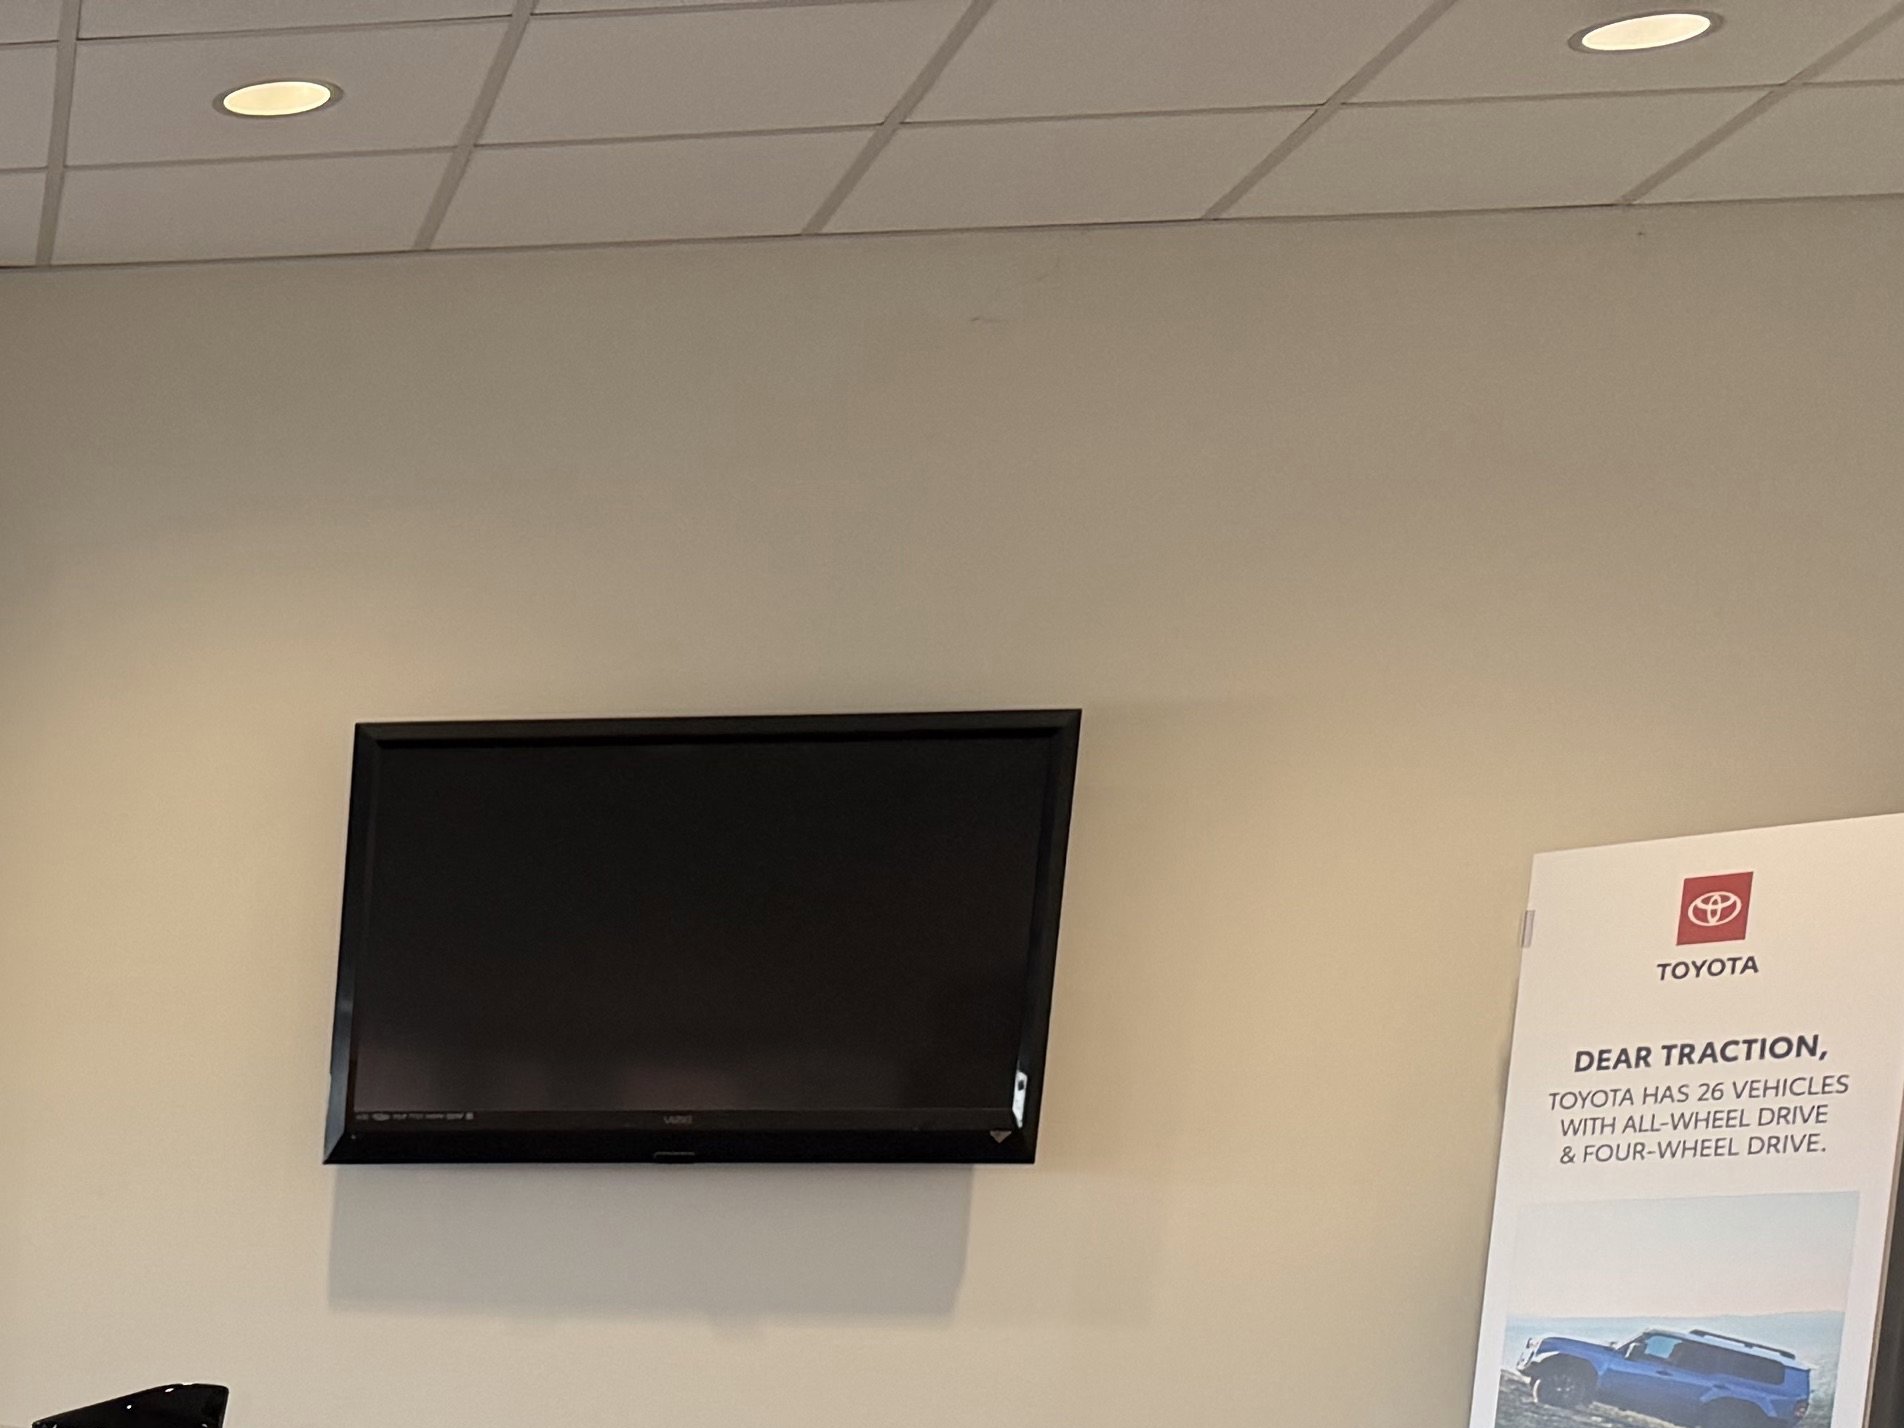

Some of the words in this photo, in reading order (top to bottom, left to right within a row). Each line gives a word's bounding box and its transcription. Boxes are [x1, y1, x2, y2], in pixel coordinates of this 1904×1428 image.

[1656, 956, 1759, 981] TOYOTA
[1574, 1046, 1652, 1073] DEAR
[1661, 1034, 1828, 1066] TRACTION,
[1548, 1088, 1634, 1111] TOYOTA
[1642, 1084, 1690, 1105] HAS
[1697, 1082, 1724, 1102] 26
[1732, 1074, 1850, 1100] VEHICLES
[1560, 1116, 1616, 1137] WITH
[1622, 1108, 1751, 1134] ALL-WHEEL
[1758, 1104, 1829, 1127] DRIVE
[1560, 1146, 1575, 1165] &
[1583, 1138, 1740, 1163] FOUR-WHEEL
[1747, 1133, 1826, 1156] DRIVE.
